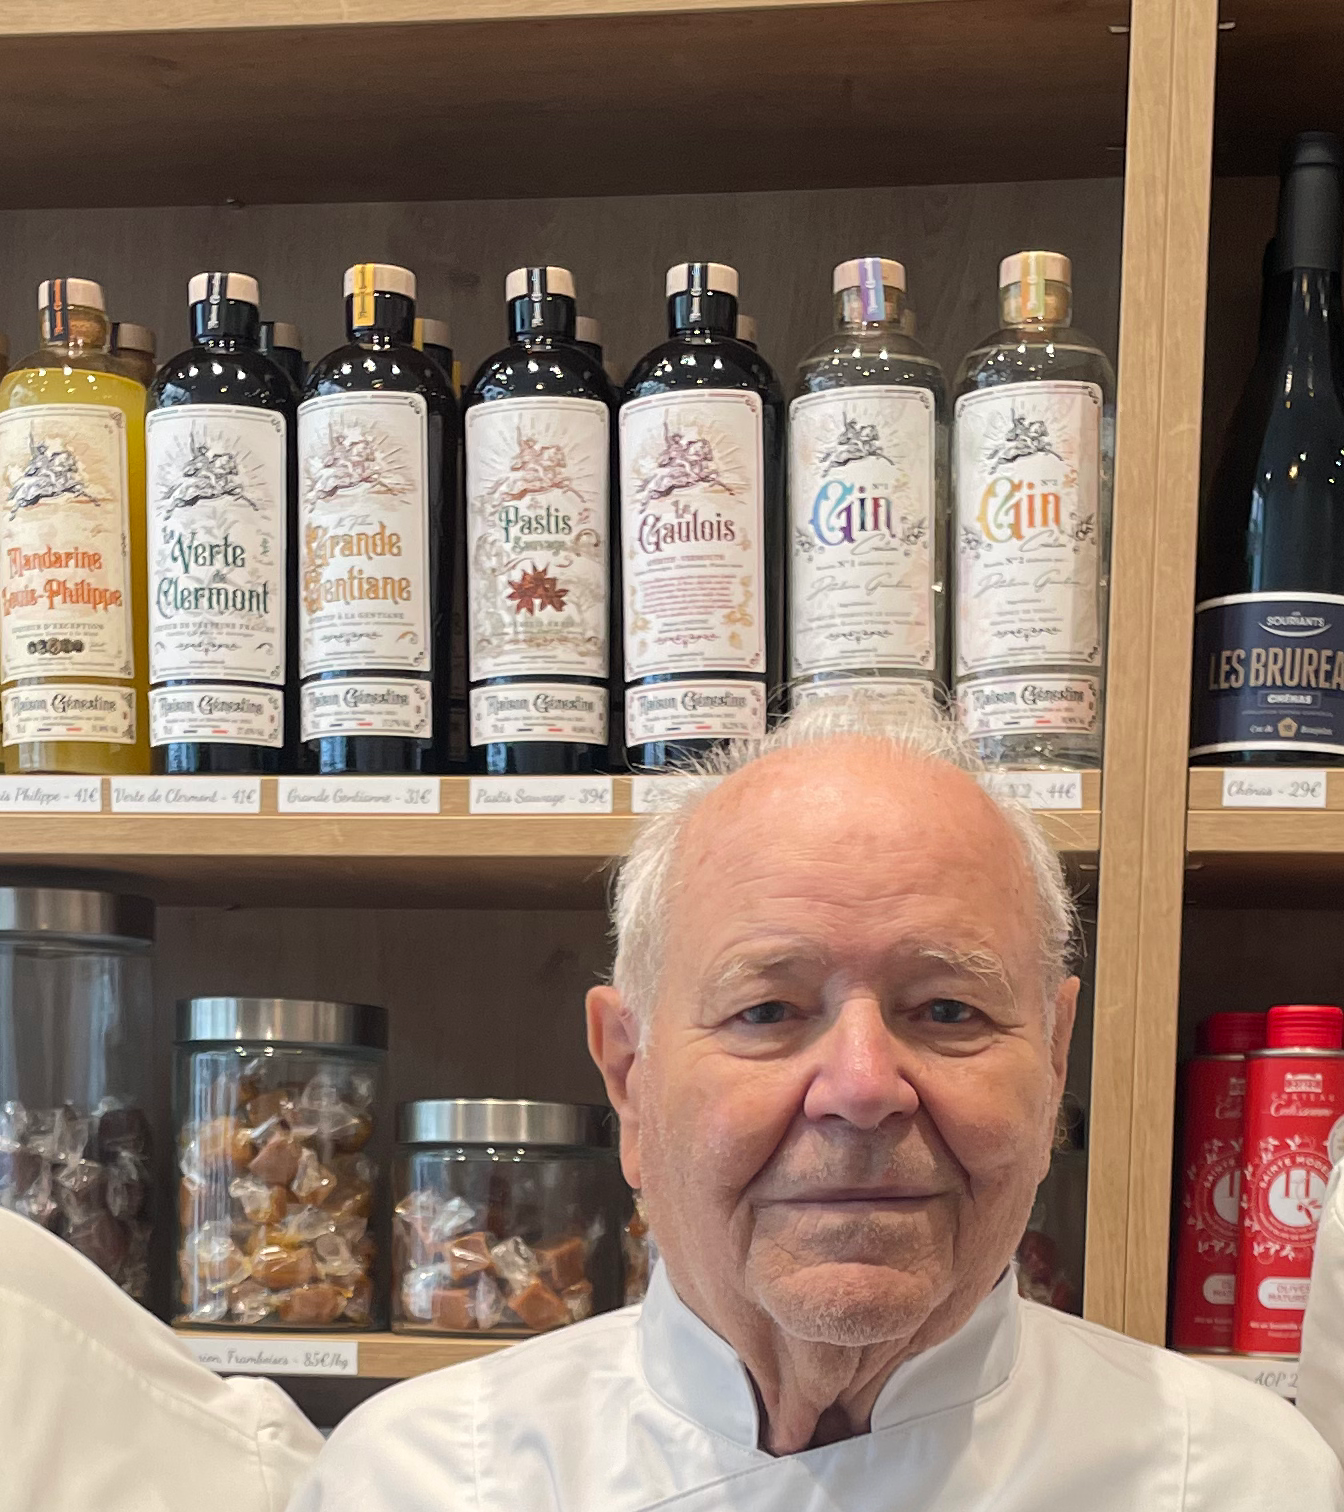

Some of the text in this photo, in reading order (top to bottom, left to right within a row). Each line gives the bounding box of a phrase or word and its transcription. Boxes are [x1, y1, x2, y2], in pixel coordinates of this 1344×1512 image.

[498, 505, 573, 543] Pastis
[809, 480, 896, 546] Gin
[976, 477, 1064, 544] Gin
[8, 544, 102, 579] Mandarine
[172, 532, 246, 574] Verte
[304, 521, 402, 567] Grande
[2, 578, 122, 616] Louis-Philippe
[156, 577, 270, 619] Clermont
[303, 566, 411, 616] Gentiane
[1209, 649, 1246, 690] LES
[15, 787, 59, 805] Philippe
[74, 787, 98, 802] 41€
[114, 788, 256, 804] Verte de Clermont 41€
[287, 788, 329, 804] Grande
[405, 788, 432, 804] 31€
[476, 788, 608, 806] Pastis Sauvage 39€
[1288, 781, 1322, 798] 29€
[227, 1350, 348, 1369] Framboises 85€/kg
